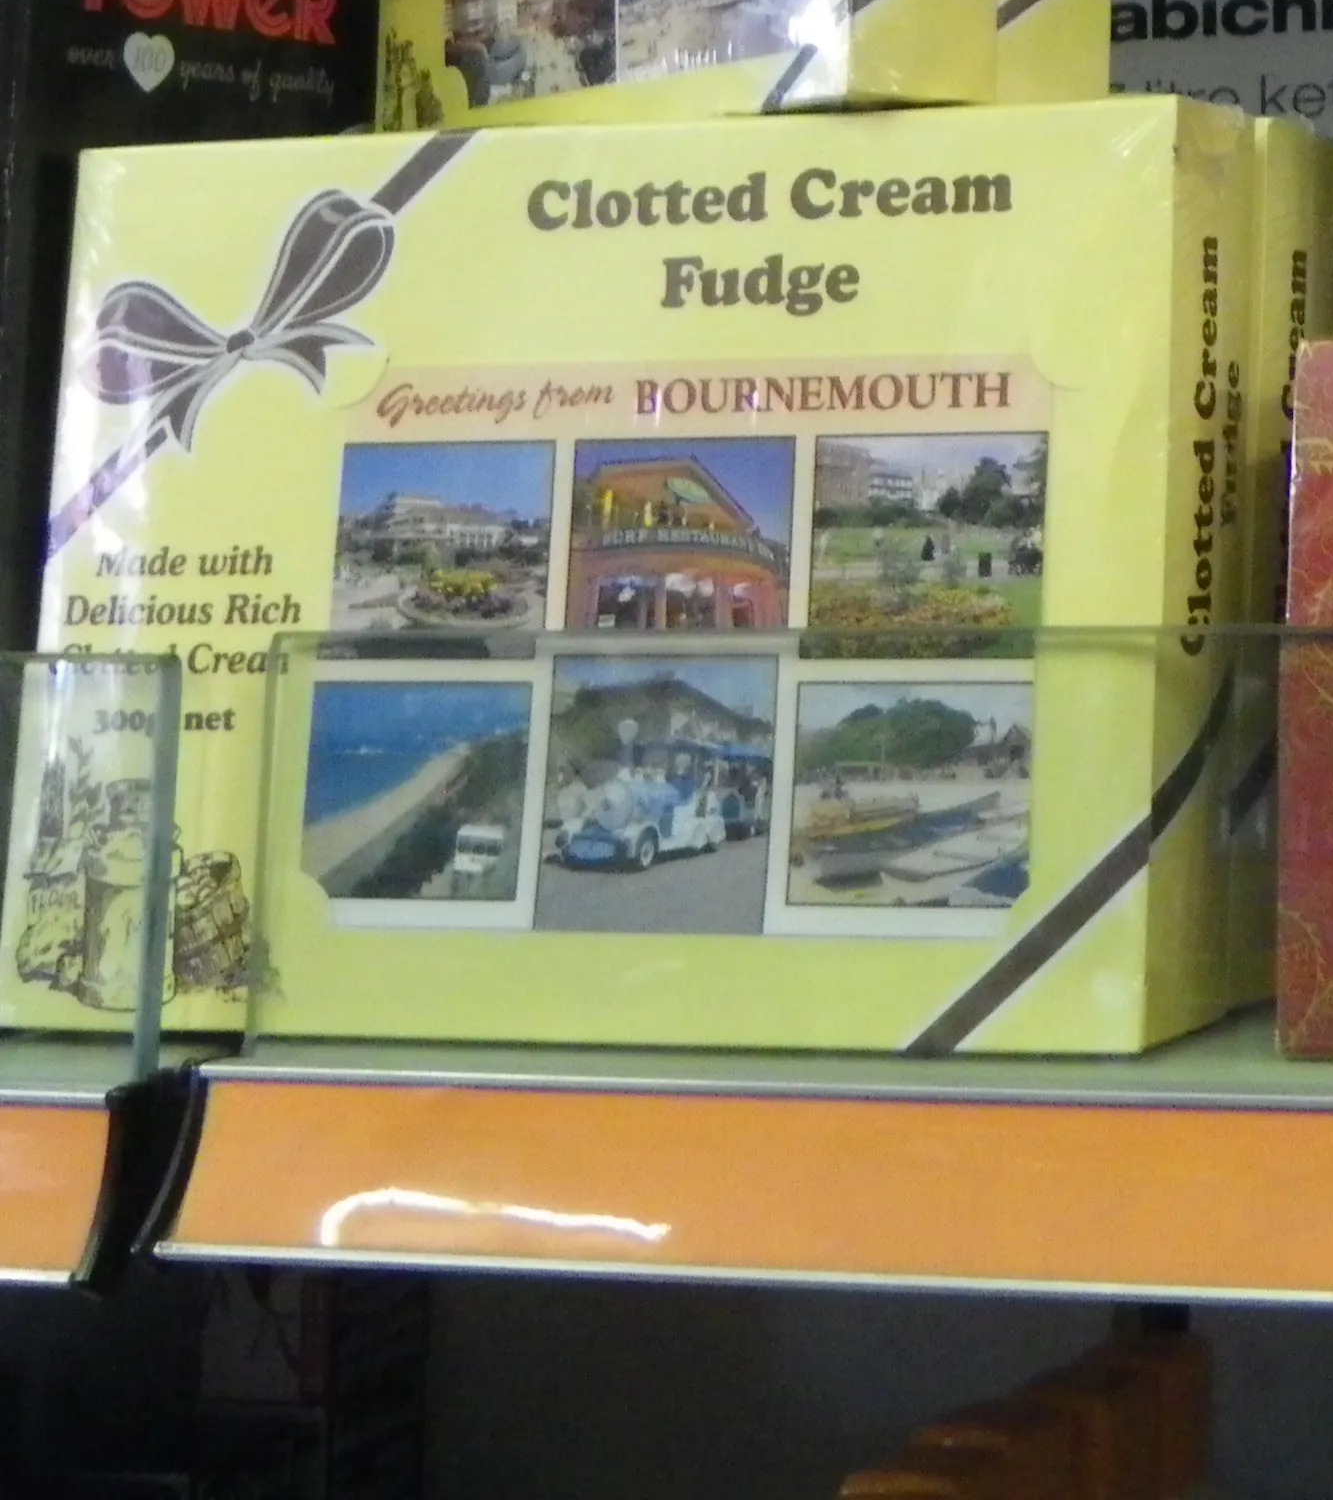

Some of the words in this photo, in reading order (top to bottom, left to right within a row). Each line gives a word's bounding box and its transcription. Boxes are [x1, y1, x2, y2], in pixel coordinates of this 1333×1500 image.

[526, 171, 768, 232] Clotted
[790, 167, 1013, 221] Cream
[659, 253, 861, 318] Fudge
[1194, 236, 1219, 420] Cream
[376, 383, 526, 428] Greetings
[533, 380, 616, 424] from
[634, 372, 1012, 417] BOURNEMOUTH
[96, 545, 187, 578] Made
[198, 544, 274, 578] with
[1180, 440, 1216, 656] Clotted
[63, 594, 214, 627] Delicious
[223, 593, 302, 626] Rich
[184, 707, 236, 731] net
